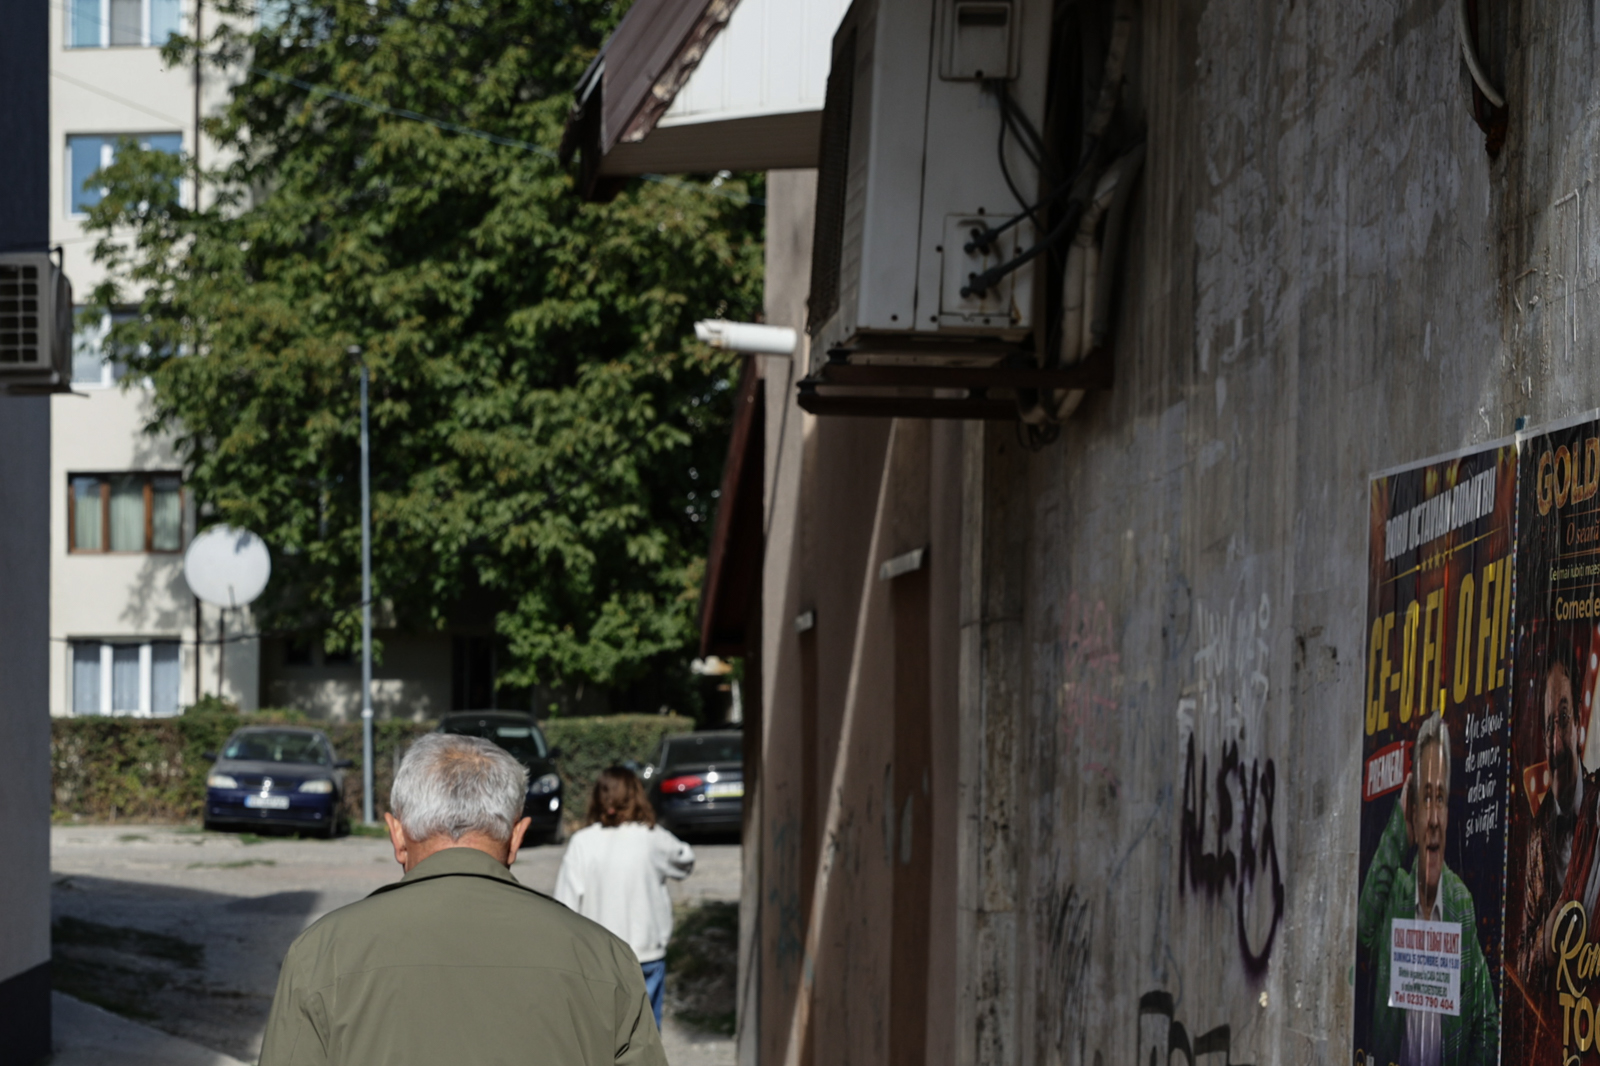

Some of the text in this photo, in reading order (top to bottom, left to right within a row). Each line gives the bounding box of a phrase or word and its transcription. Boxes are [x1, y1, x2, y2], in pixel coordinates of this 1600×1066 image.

[1384, 465, 1496, 562] DORU OCTAVIAN DUMITRU
[1536, 436, 1600, 516] GOLD
[1453, 573, 1475, 704] O
[1475, 555, 1512, 697] FI!
[1465, 748, 1477, 773] de
[1480, 704, 1503, 738] show
